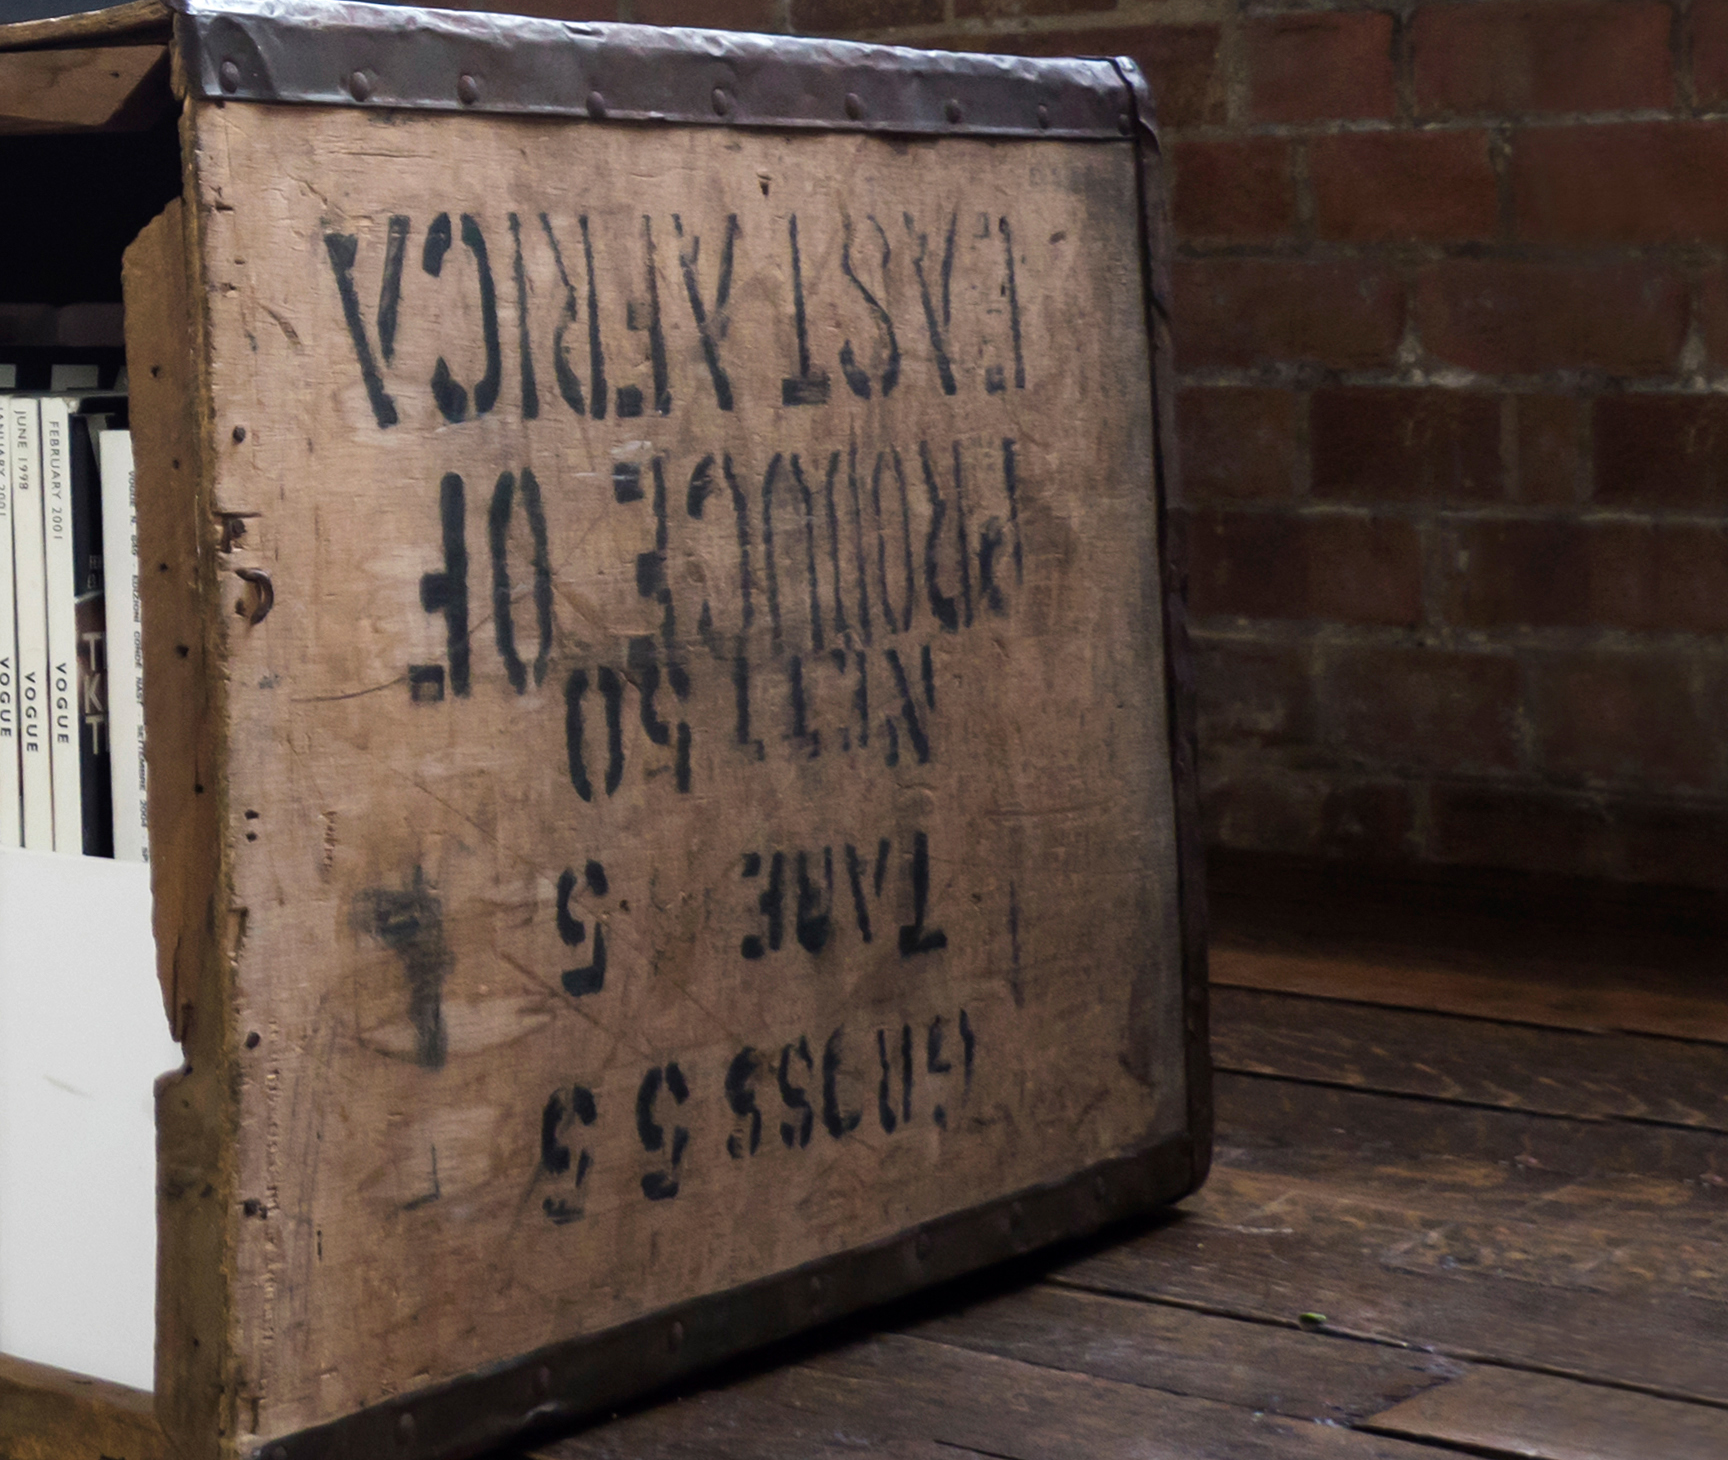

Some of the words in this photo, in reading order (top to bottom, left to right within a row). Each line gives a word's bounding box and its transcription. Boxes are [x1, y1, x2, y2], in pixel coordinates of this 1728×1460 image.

[323, 211, 737, 430] AFRICA
[782, 209, 1026, 407] EAST
[14, 410, 28, 448] JUNE
[18, 457, 29, 490] 1998
[48, 421, 62, 499] FEBRUARY
[52, 507, 63, 540] 2001
[611, 437, 1023, 666] PRODUCE
[408, 469, 552, 703] OF
[0, 657, 12, 737] VOGUE
[24, 672, 38, 754] VOGUE
[55, 663, 69, 744] VOGUE
[565, 664, 693, 803] 50
[554, 860, 608, 998] 5
[740, 830, 948, 961] TARE
